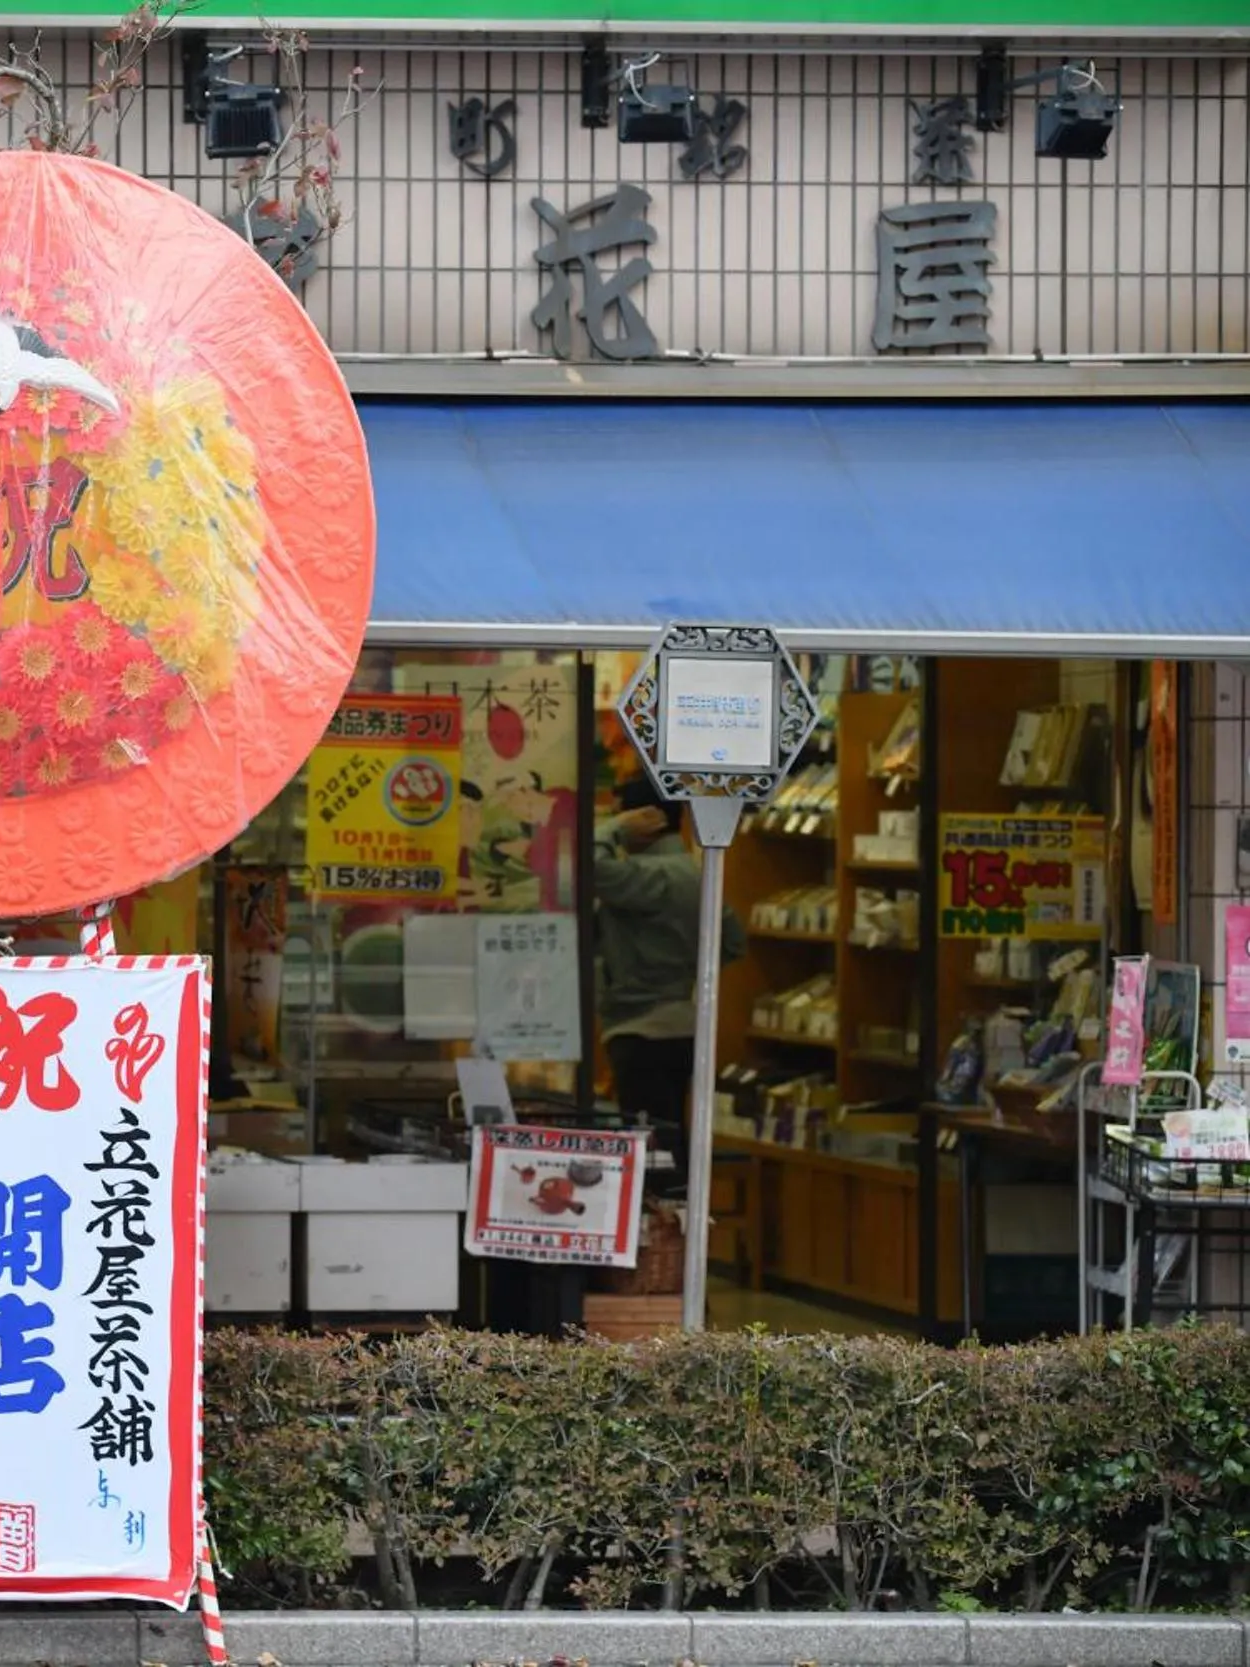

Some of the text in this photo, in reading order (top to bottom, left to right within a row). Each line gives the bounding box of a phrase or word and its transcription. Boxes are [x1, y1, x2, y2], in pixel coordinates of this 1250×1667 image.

[322, 867, 442, 890] 15%お得
[77, 1107, 160, 1466] 立花屋茶舗
